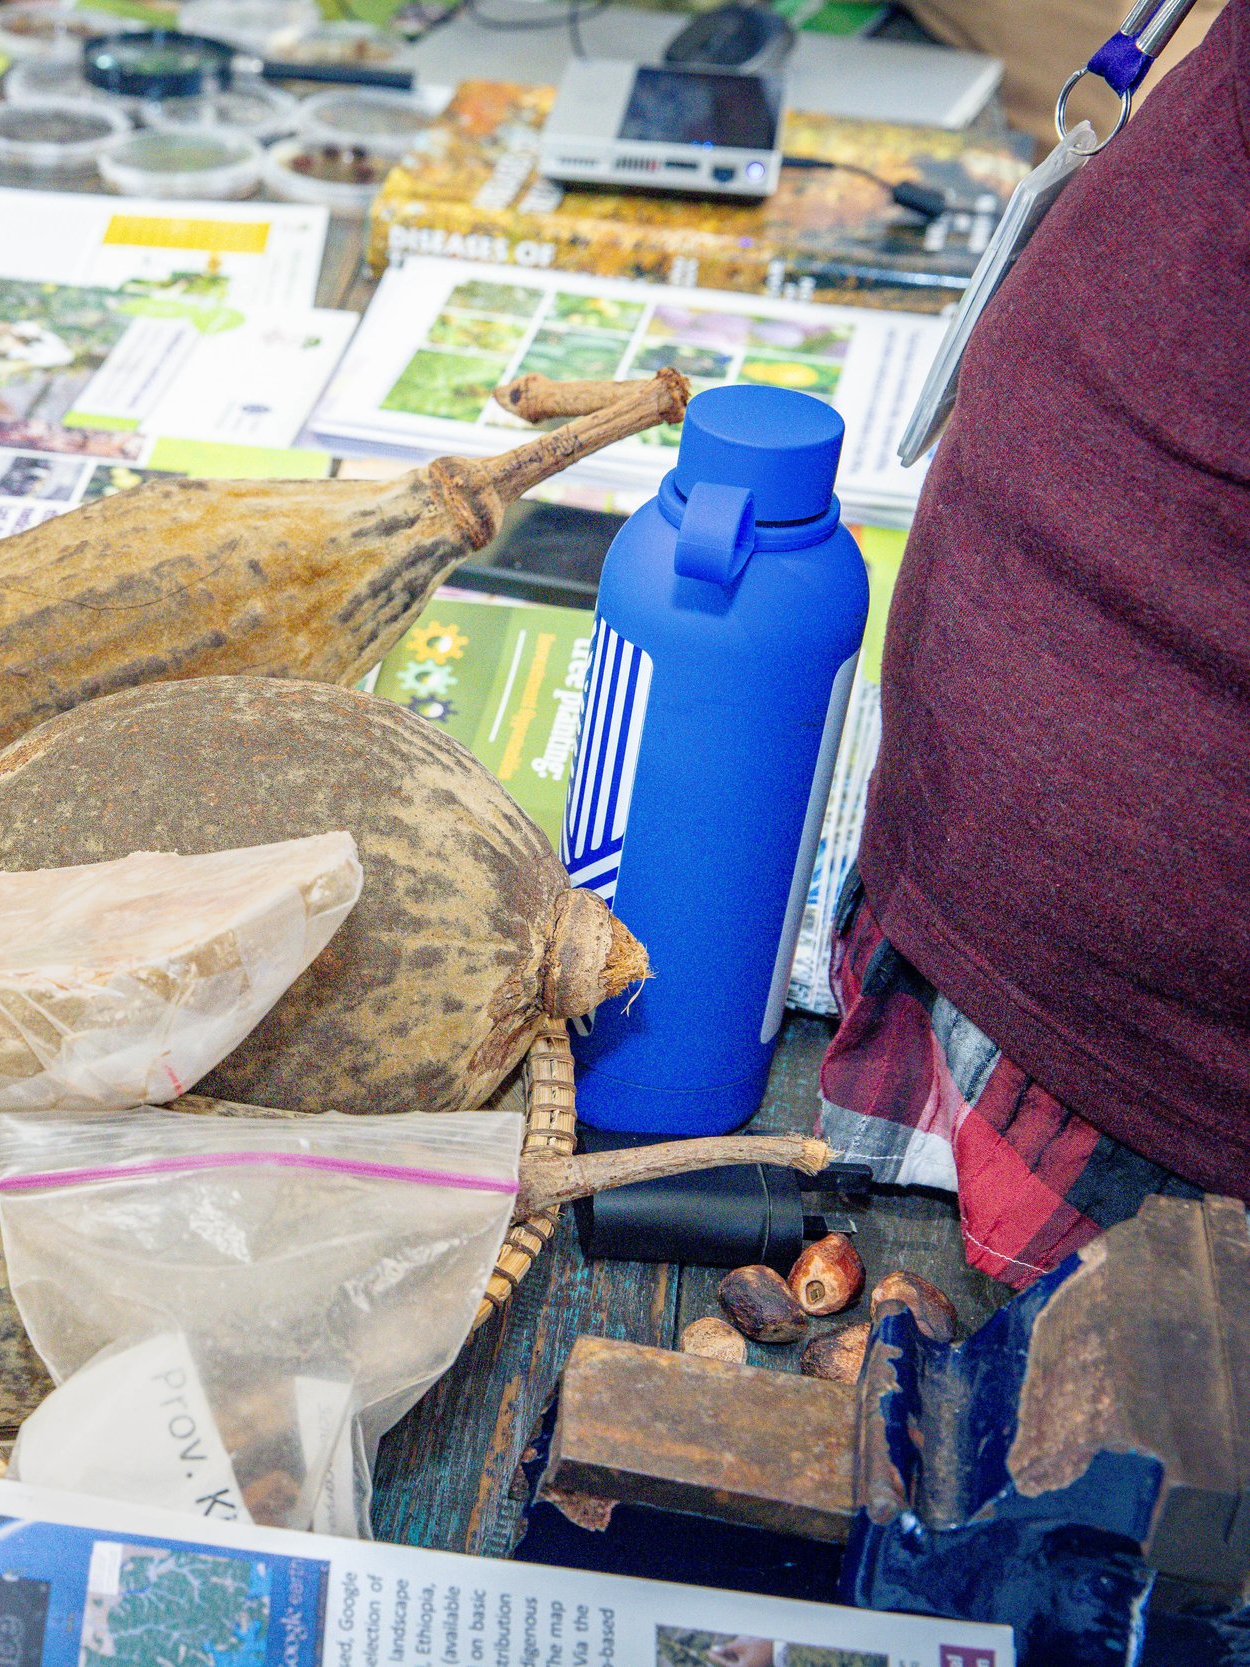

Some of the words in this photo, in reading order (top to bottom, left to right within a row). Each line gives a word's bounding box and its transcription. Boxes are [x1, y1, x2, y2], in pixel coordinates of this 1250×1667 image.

[195, 1488, 239, 1520] K
[338, 1572, 361, 1631] Google
[368, 1573, 383, 1592] of
[389, 1578, 411, 1662] landscape
[415, 1582, 437, 1656] Ethiopia,
[441, 1585, 461, 1665] (available
[469, 1589, 486, 1631] basic
[549, 1600, 566, 1638] map
[573, 1604, 589, 1632] the
[471, 1639, 483, 1661] on
